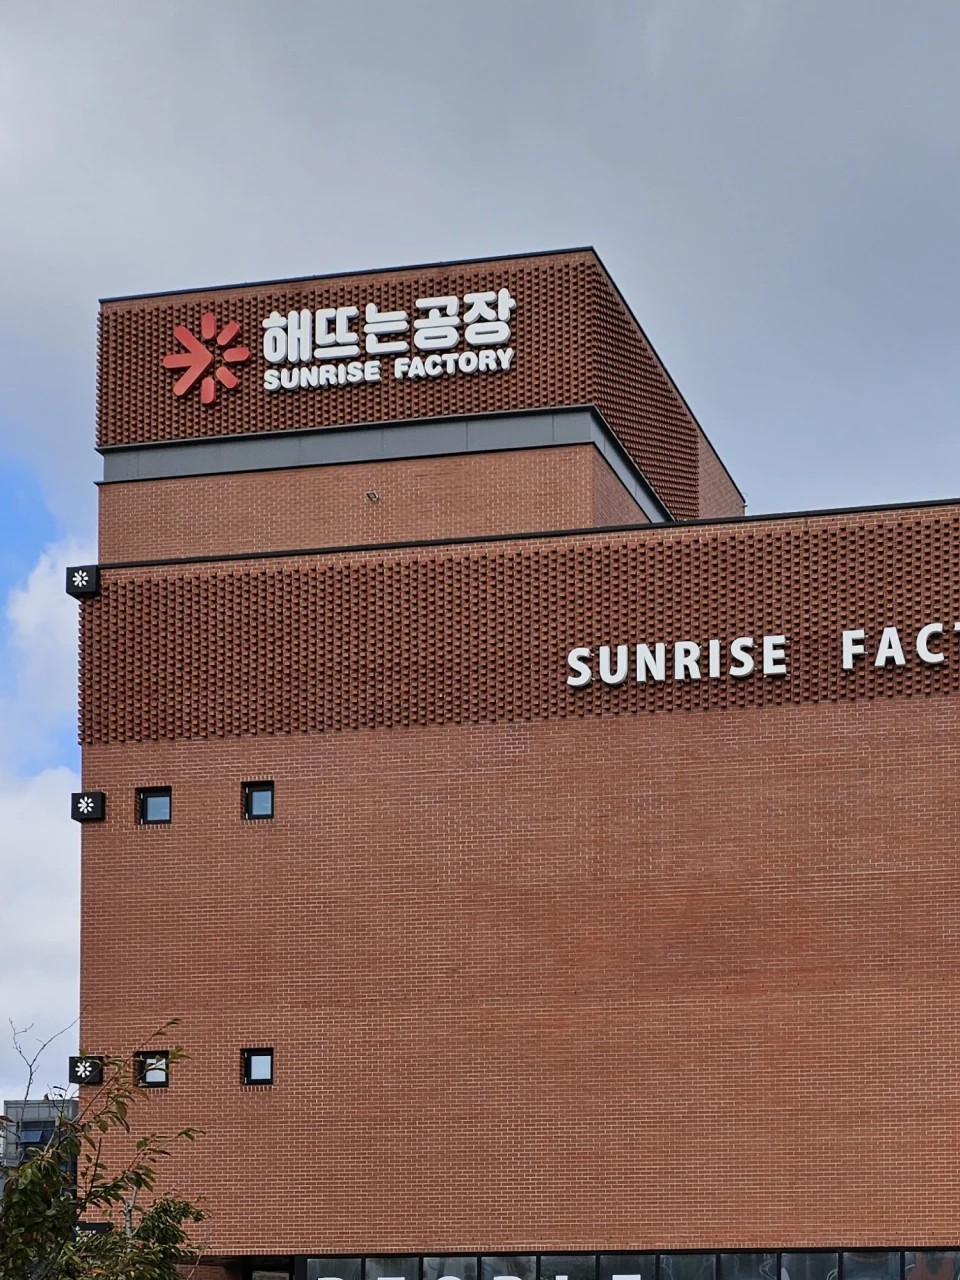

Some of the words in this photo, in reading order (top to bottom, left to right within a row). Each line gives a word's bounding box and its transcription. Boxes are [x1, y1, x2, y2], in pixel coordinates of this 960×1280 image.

[262, 287, 516, 364] 해뜨는공장
[263, 360, 382, 392] SUNRISE
[394, 347, 515, 380] FACTORY
[566, 634, 788, 688] SUNRISE
